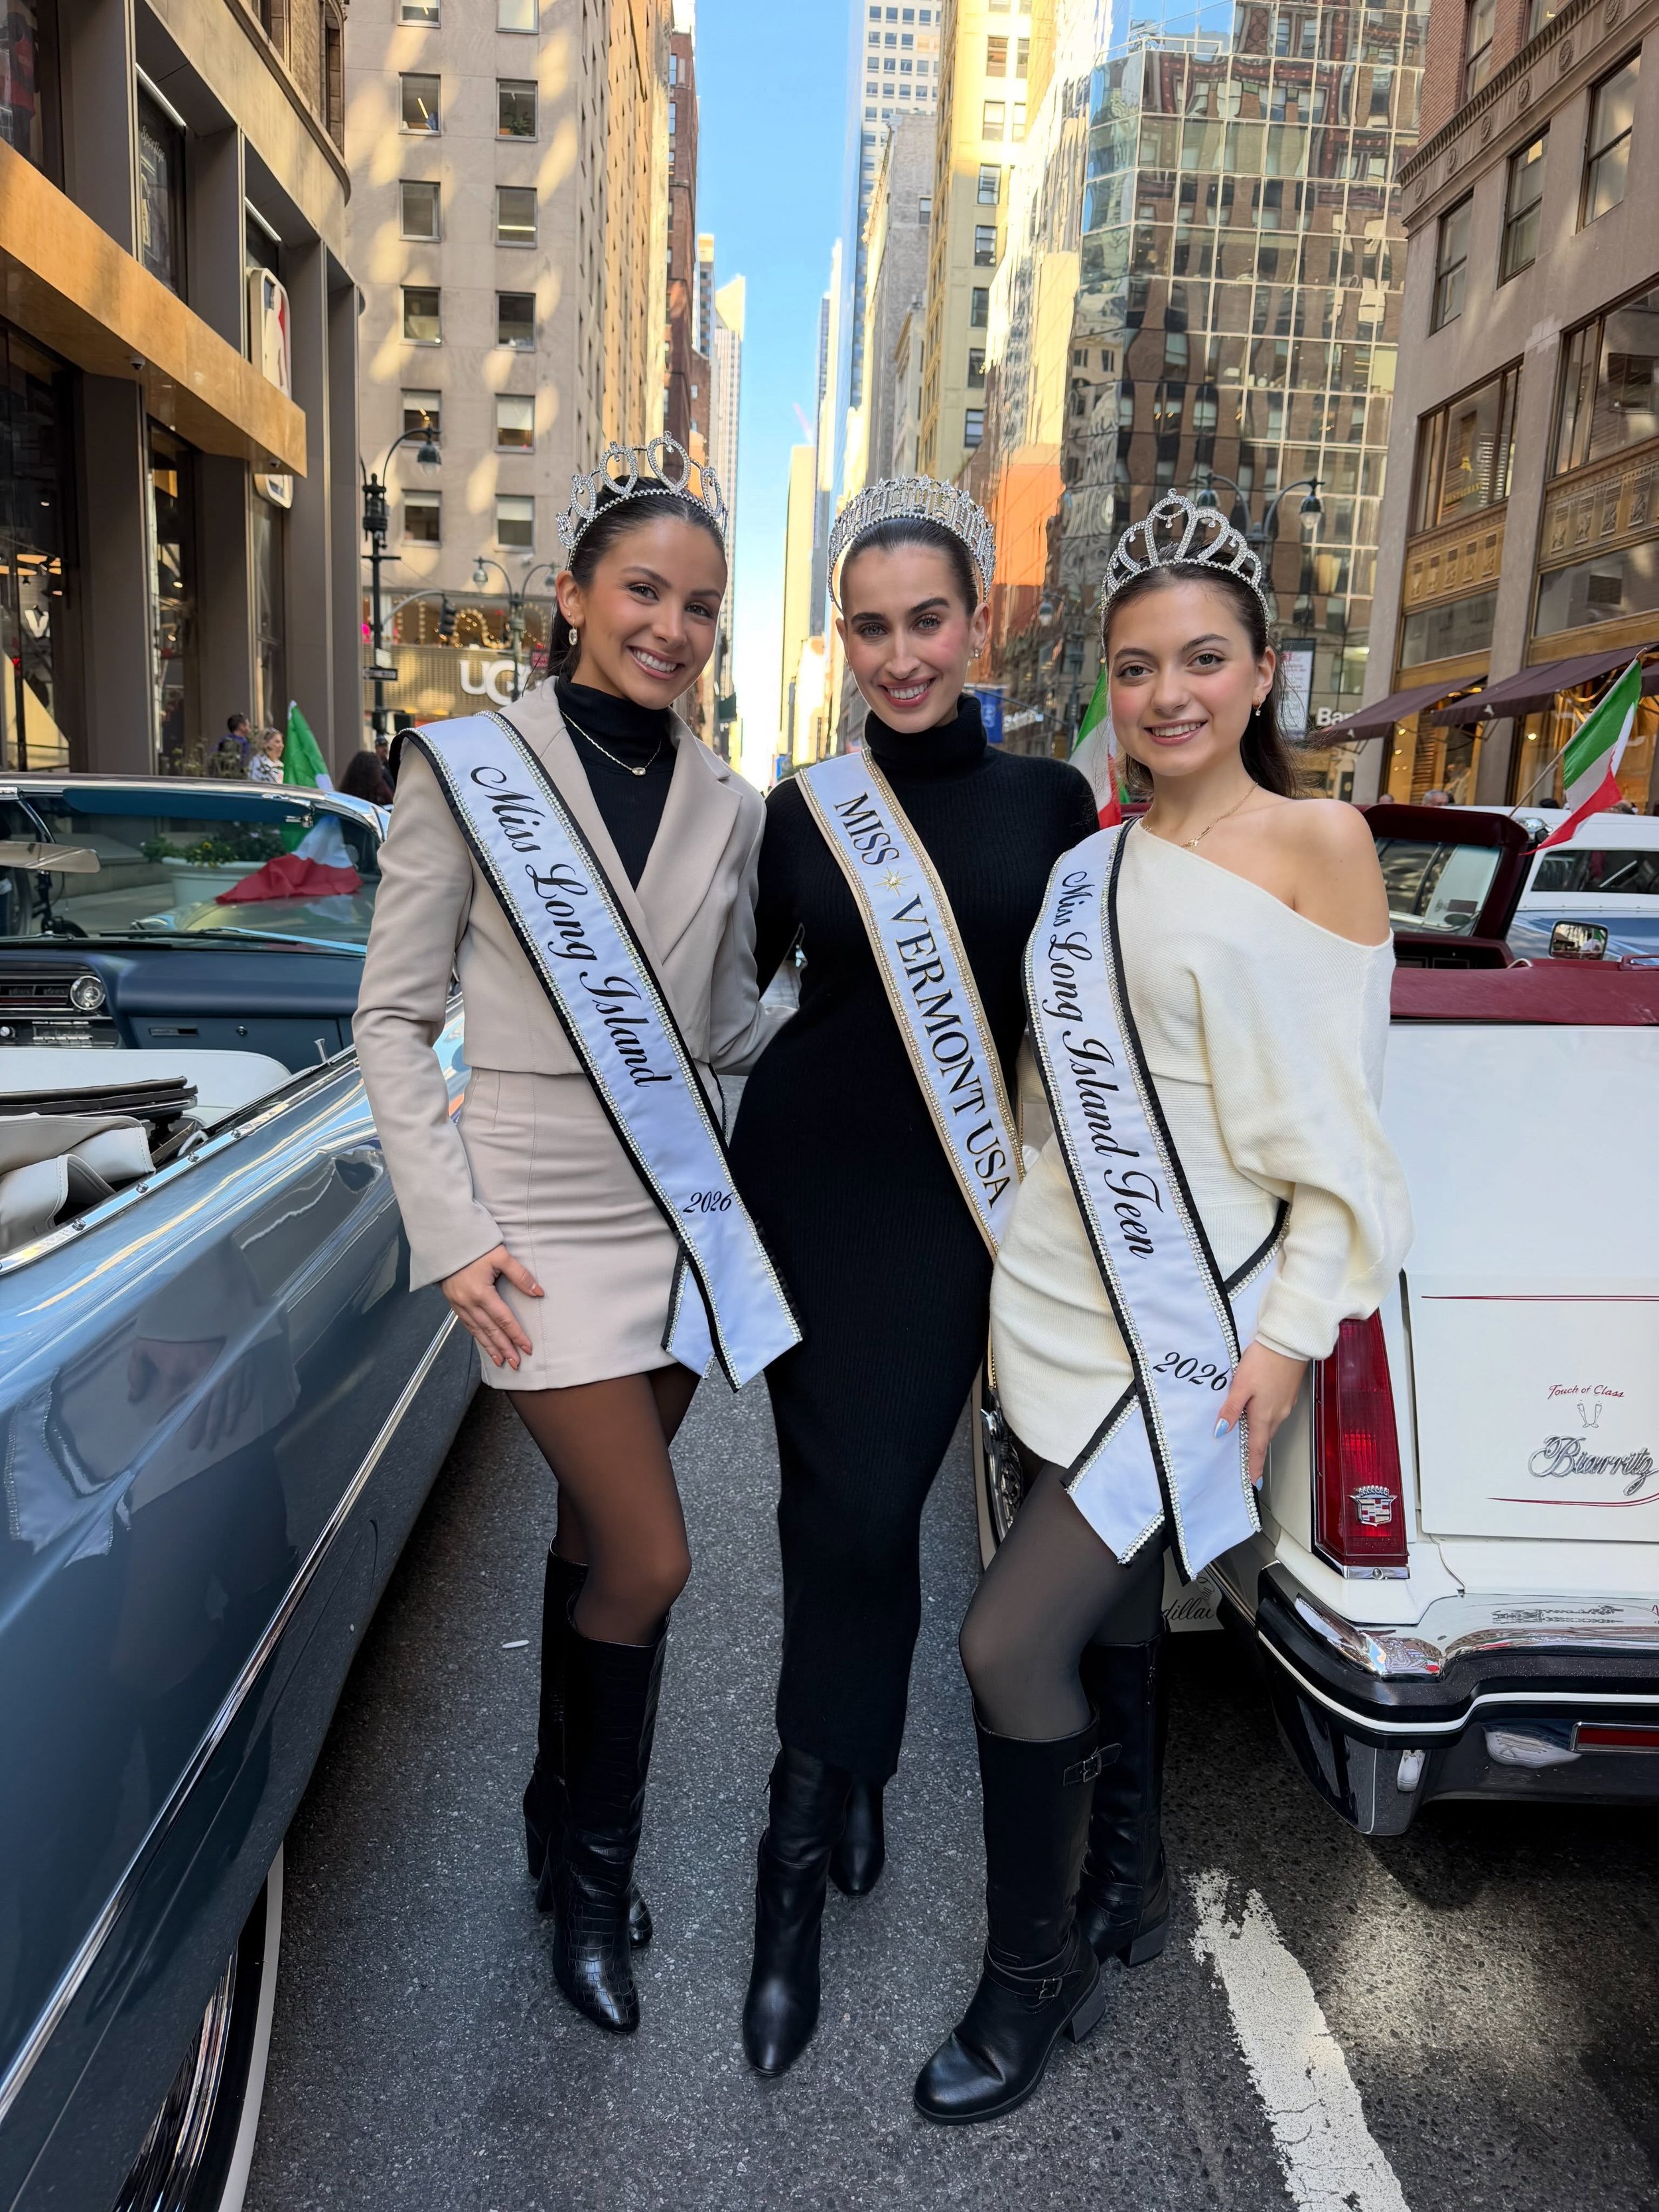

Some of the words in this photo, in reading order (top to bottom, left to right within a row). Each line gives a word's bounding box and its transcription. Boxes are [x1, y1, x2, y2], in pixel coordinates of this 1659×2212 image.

[470, 767, 545, 852] Miss
[525, 863, 597, 960] Long
[579, 971, 672, 1087] Island
[1052, 870, 1094, 926] Miss
[833, 791, 900, 865] MISS
[886, 893, 985, 1118] VERMONT
[966, 1118, 1021, 1210] USA
[1043, 931, 1093, 1023] Long
[1061, 1029, 1140, 1158] Island
[682, 1191, 734, 1213] 2026
[1104, 1169, 1165, 1260] Teen
[1152, 1351, 1231, 1391] 2026
[1547, 1384, 1579, 1400] Touch
[1593, 1384, 1625, 1398] Class
